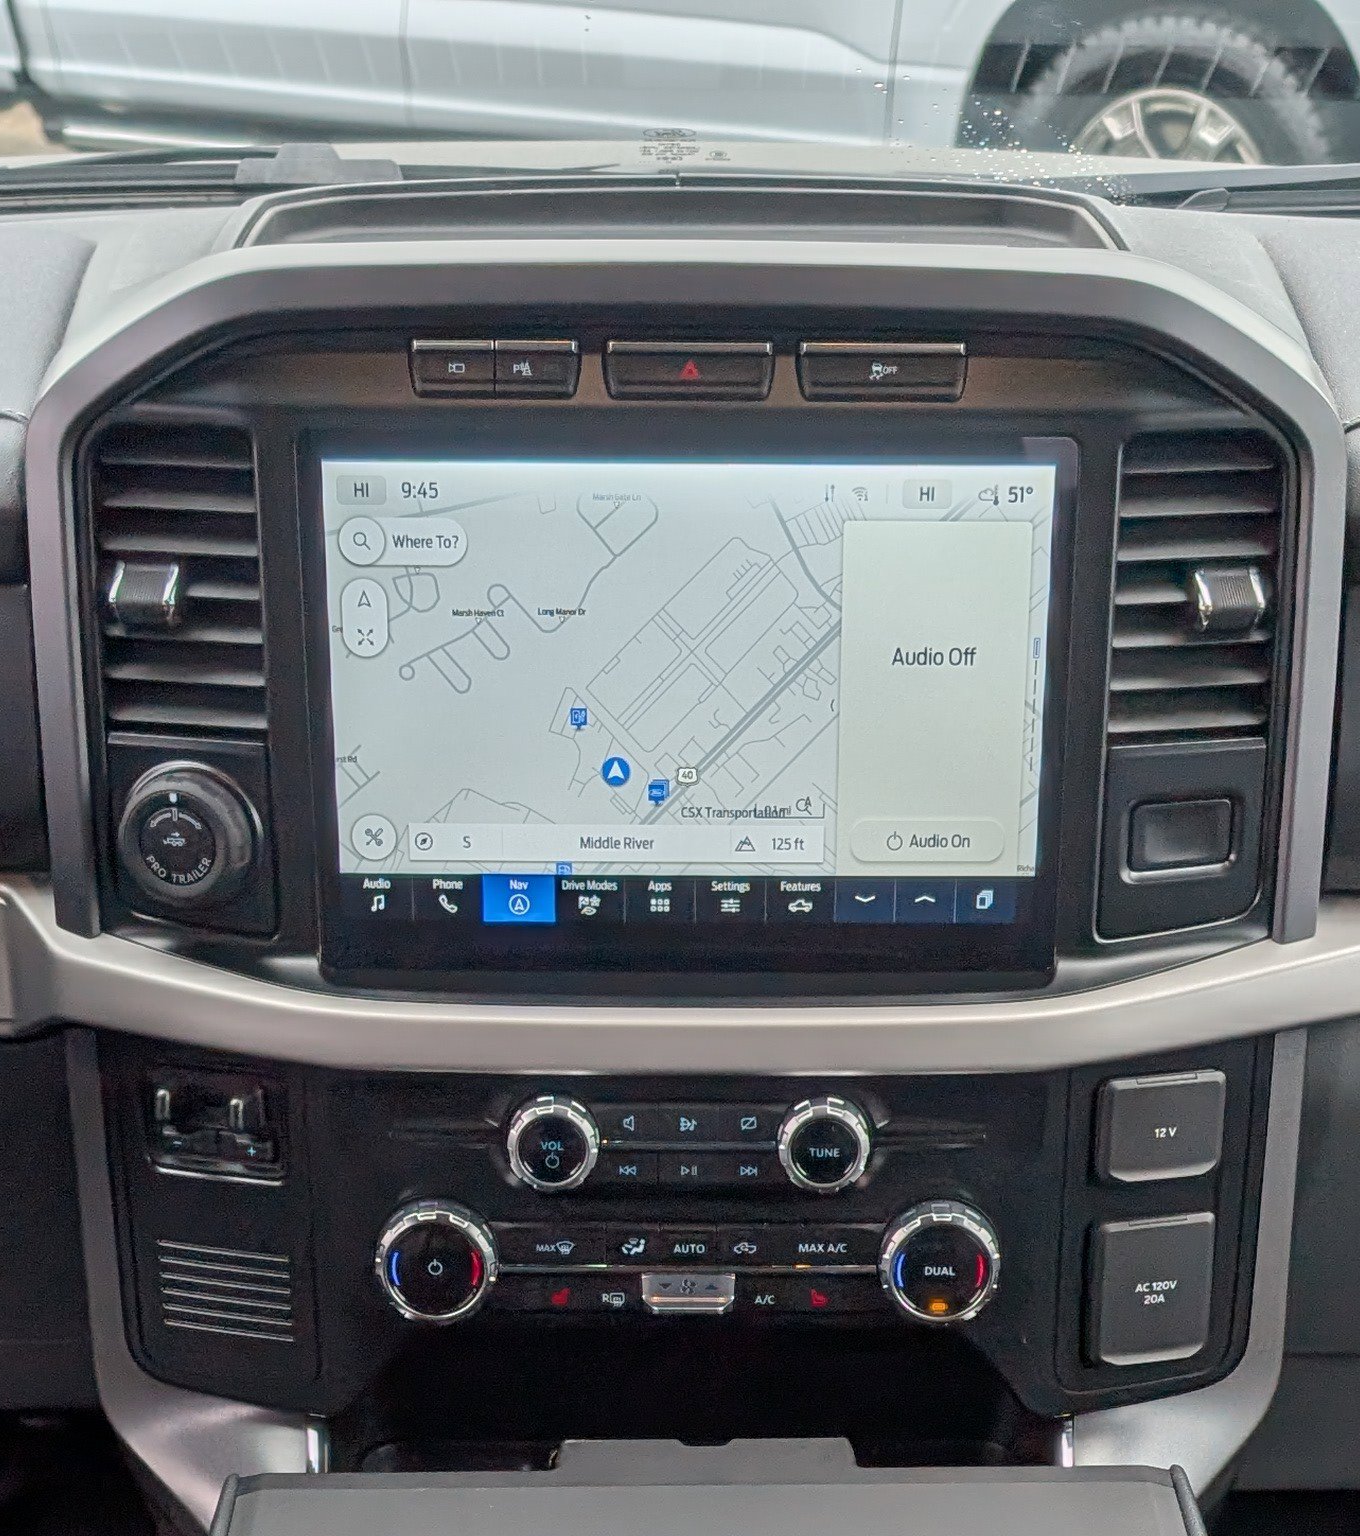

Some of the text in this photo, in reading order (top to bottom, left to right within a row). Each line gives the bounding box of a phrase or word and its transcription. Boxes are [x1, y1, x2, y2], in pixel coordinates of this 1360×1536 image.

[883, 365, 898, 375] OFF
[353, 482, 370, 498] HI
[401, 481, 439, 499] 9:45
[918, 486, 935, 502] HI
[1007, 486, 1034, 503] 51°
[392, 534, 459, 549] Where To?
[452, 609, 472, 617] Marsh
[537, 608, 555, 617] Long
[556, 608, 577, 616] Manor
[891, 647, 977, 666] Audio Off
[681, 771, 694, 780] 40
[681, 807, 703, 818] CSX
[463, 836, 471, 849] S
[580, 836, 654, 849] Middle River
[771, 837, 804, 850] 125 ft
[909, 834, 970, 848] Audio On
[146, 855, 212, 884] PRO TRAILER
[363, 878, 391, 889] Audio
[432, 878, 463, 889] Phone
[509, 879, 529, 890] Nav
[561, 880, 618, 891] Drive Modes
[647, 881, 672, 893] Apps
[711, 881, 750, 893] Settings
[780, 881, 821, 892] Features
[1154, 1126, 1177, 1139] 12 V
[541, 1141, 564, 1151] VOL
[809, 1147, 840, 1158] TUNE
[536, 1243, 556, 1253] MAX
[673, 1243, 706, 1254] AUTO
[798, 1243, 848, 1253] MAX A/C
[924, 1266, 955, 1277] DUAL
[1135, 1280, 1177, 1293] AC 120V
[755, 1295, 775, 1305] A/C
[1144, 1294, 1165, 1305] 20A
